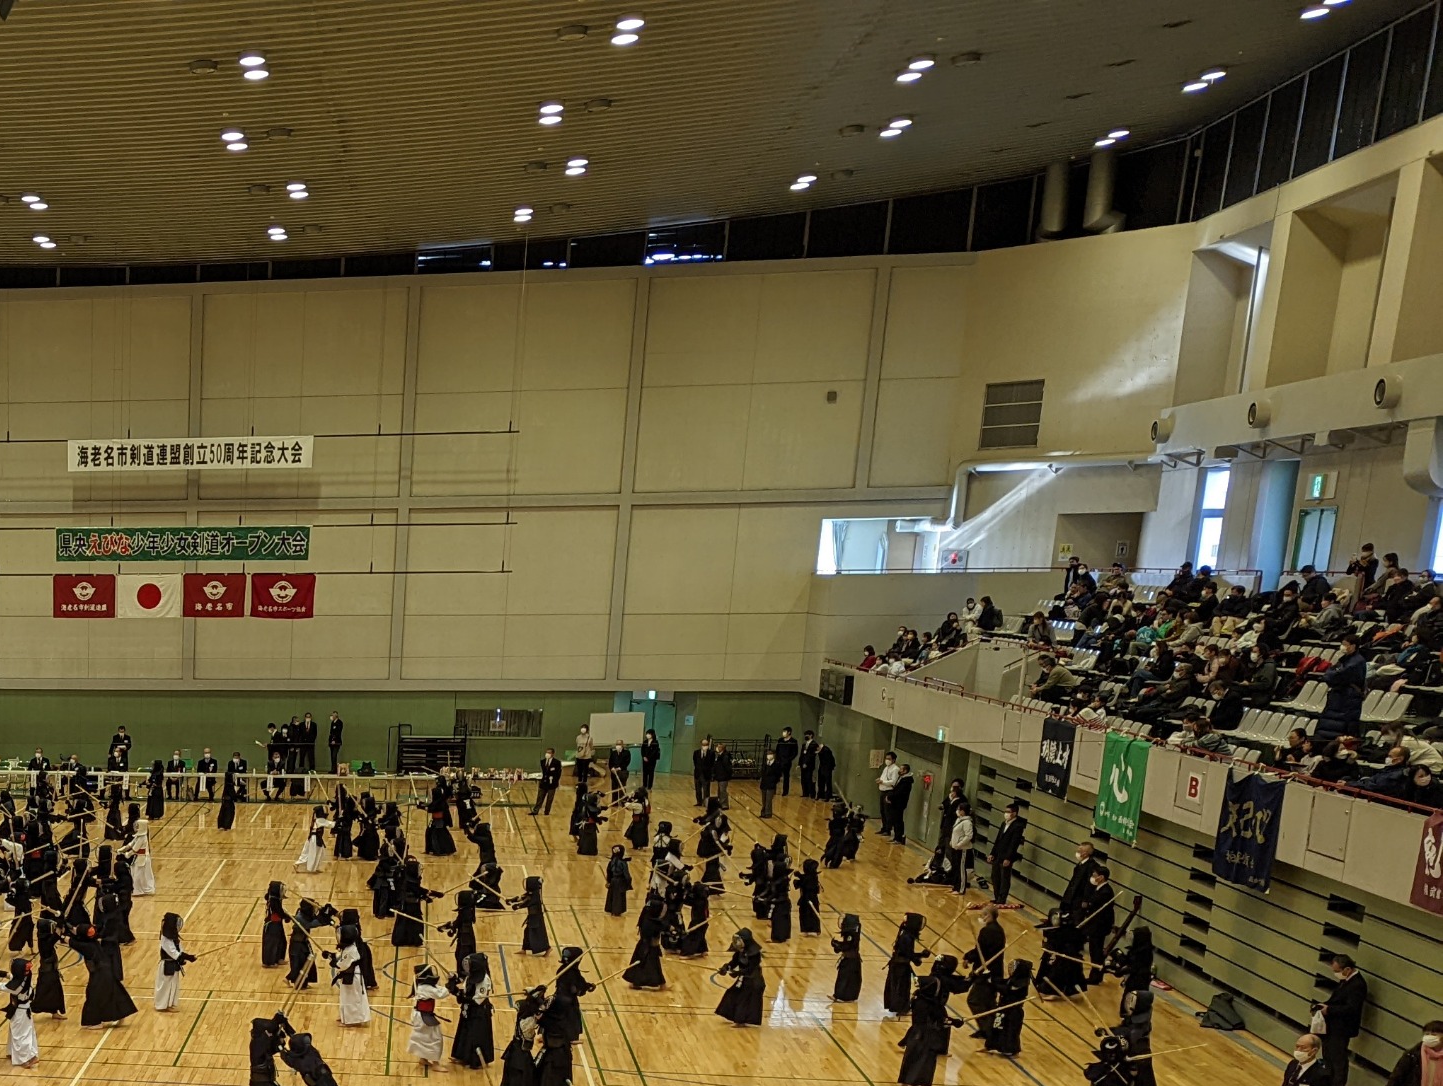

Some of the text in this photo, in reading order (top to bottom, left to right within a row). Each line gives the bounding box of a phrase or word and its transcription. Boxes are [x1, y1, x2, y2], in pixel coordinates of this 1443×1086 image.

[77, 441, 303, 467] 海老名市剣道連盟創立50周年記念大会
[58, 531, 307, 555] 県央えびな少年少女剣道オープン大会
[195, 602, 234, 611] 海老名市
[1109, 753, 1133, 803] 心
[1188, 775, 1199, 798] B
